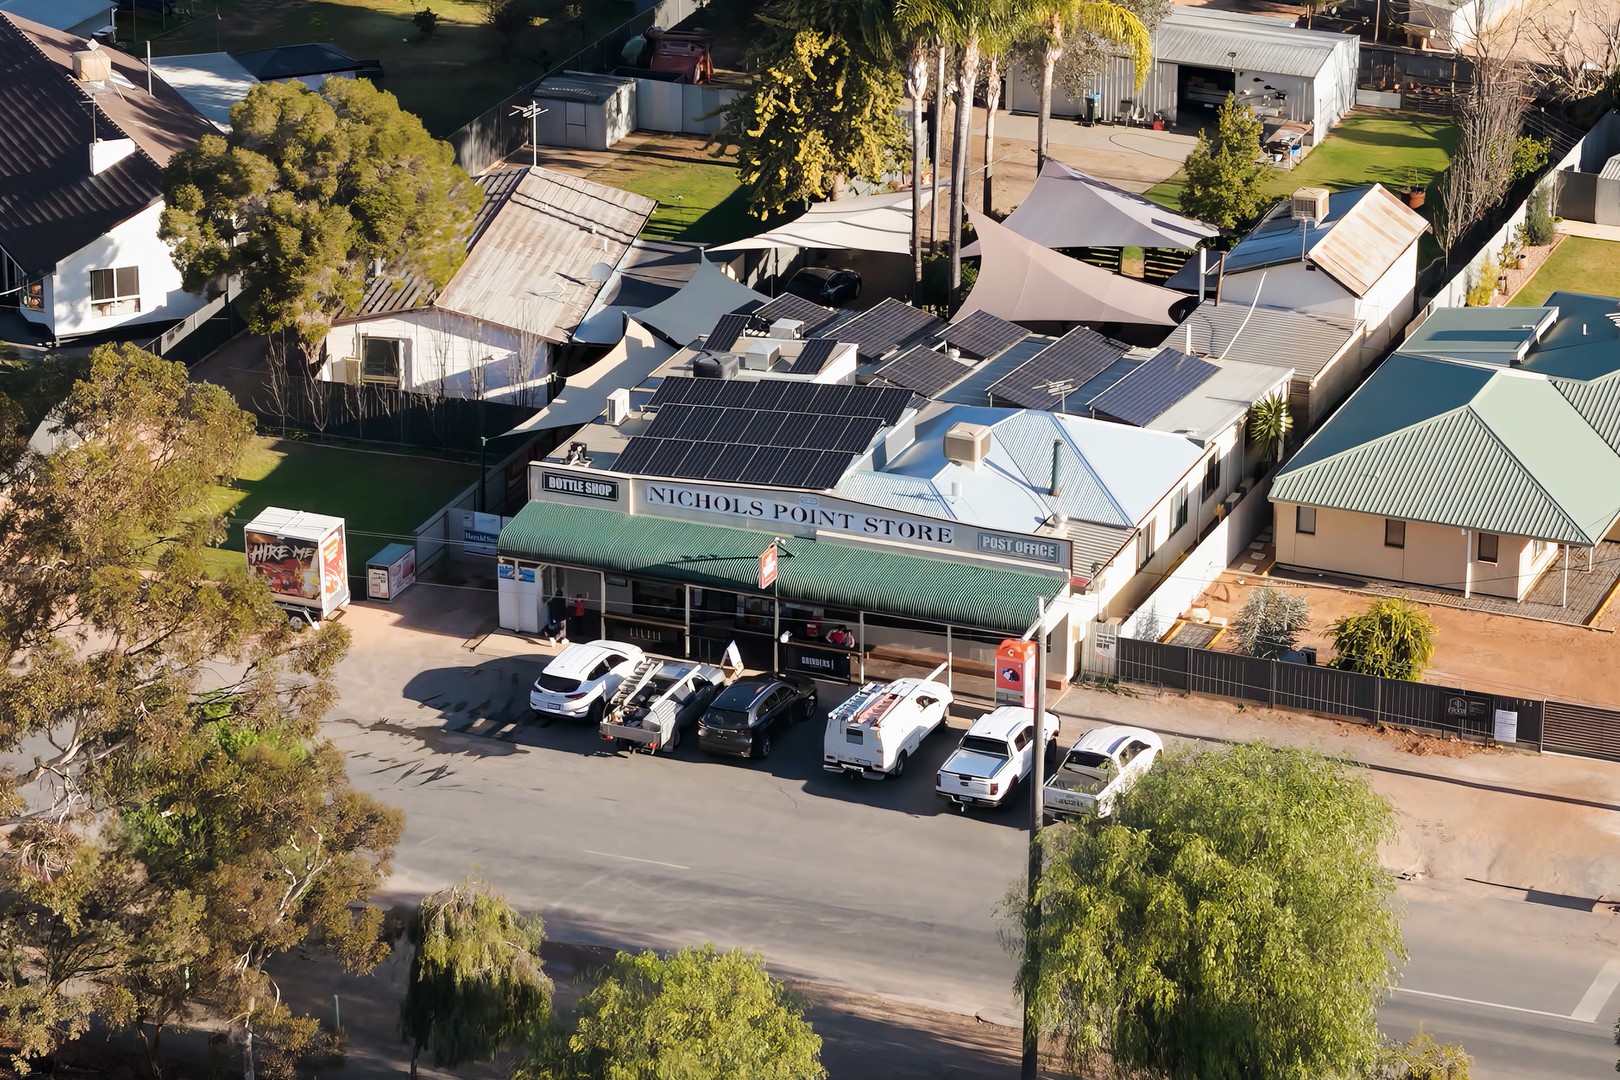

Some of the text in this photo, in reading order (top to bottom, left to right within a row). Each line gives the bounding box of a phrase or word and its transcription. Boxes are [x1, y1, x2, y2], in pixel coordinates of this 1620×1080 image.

[549, 477, 612, 497] BOTTLE SHOP
[649, 487, 954, 543] NICHOLS POINT STORE
[249, 543, 289, 564] HIRE
[292, 545, 316, 561] ME
[982, 535, 1055, 558] POST OFFICE
